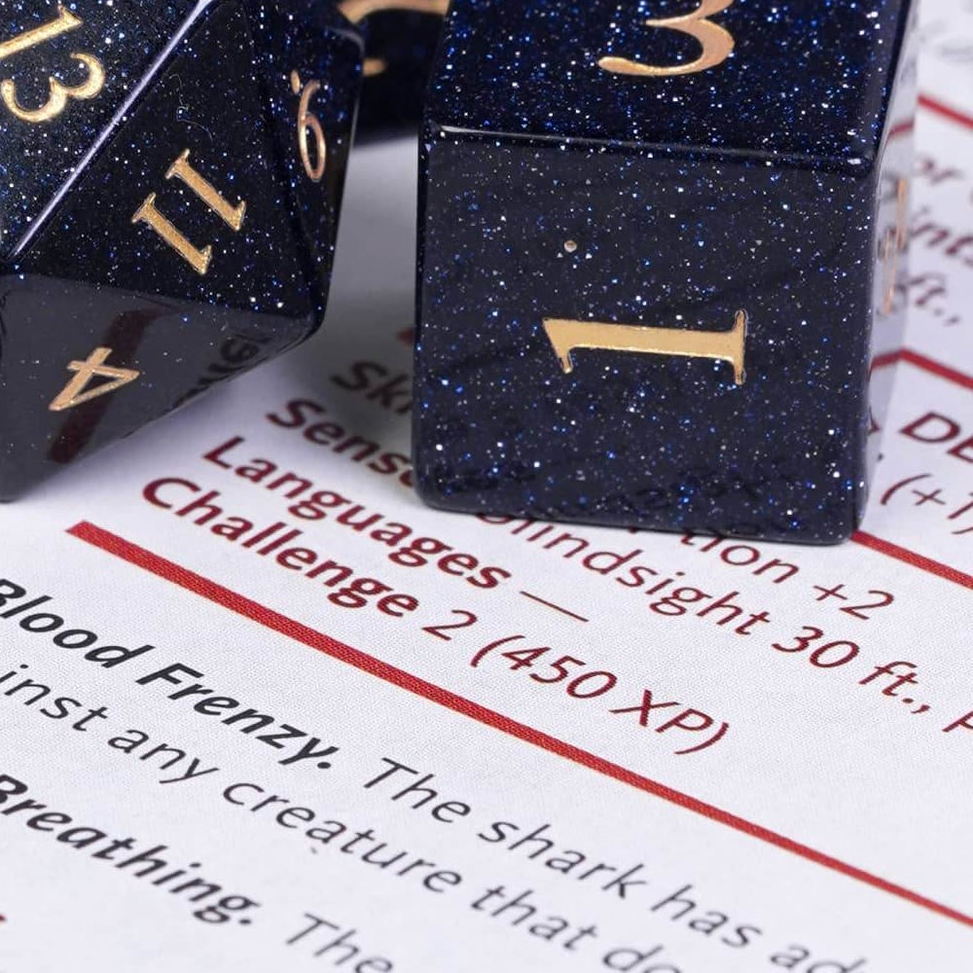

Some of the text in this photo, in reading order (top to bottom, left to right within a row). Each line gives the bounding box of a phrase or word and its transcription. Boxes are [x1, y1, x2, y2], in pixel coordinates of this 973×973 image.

[131, 148, 247, 275] 11
[48, 346, 139, 412] 4
[542, 308, 748, 387] 1
[202, 435, 512, 591] Languages
[141, 476, 729, 755] Challenge 2 (450 XP)
[813, 583, 895, 620] +2
[771, 625, 860, 669] 30
[859, 661, 931, 715] ft.,
[108, 727, 220, 785] any
[222, 781, 463, 894] creature
[470, 884, 599, 951] that
[135, 660, 332, 771] Frenzy.
[362, 756, 472, 823] The
[477, 819, 648, 900] shark
[650, 883, 763, 949] has
[285, 912, 394, 973] The
